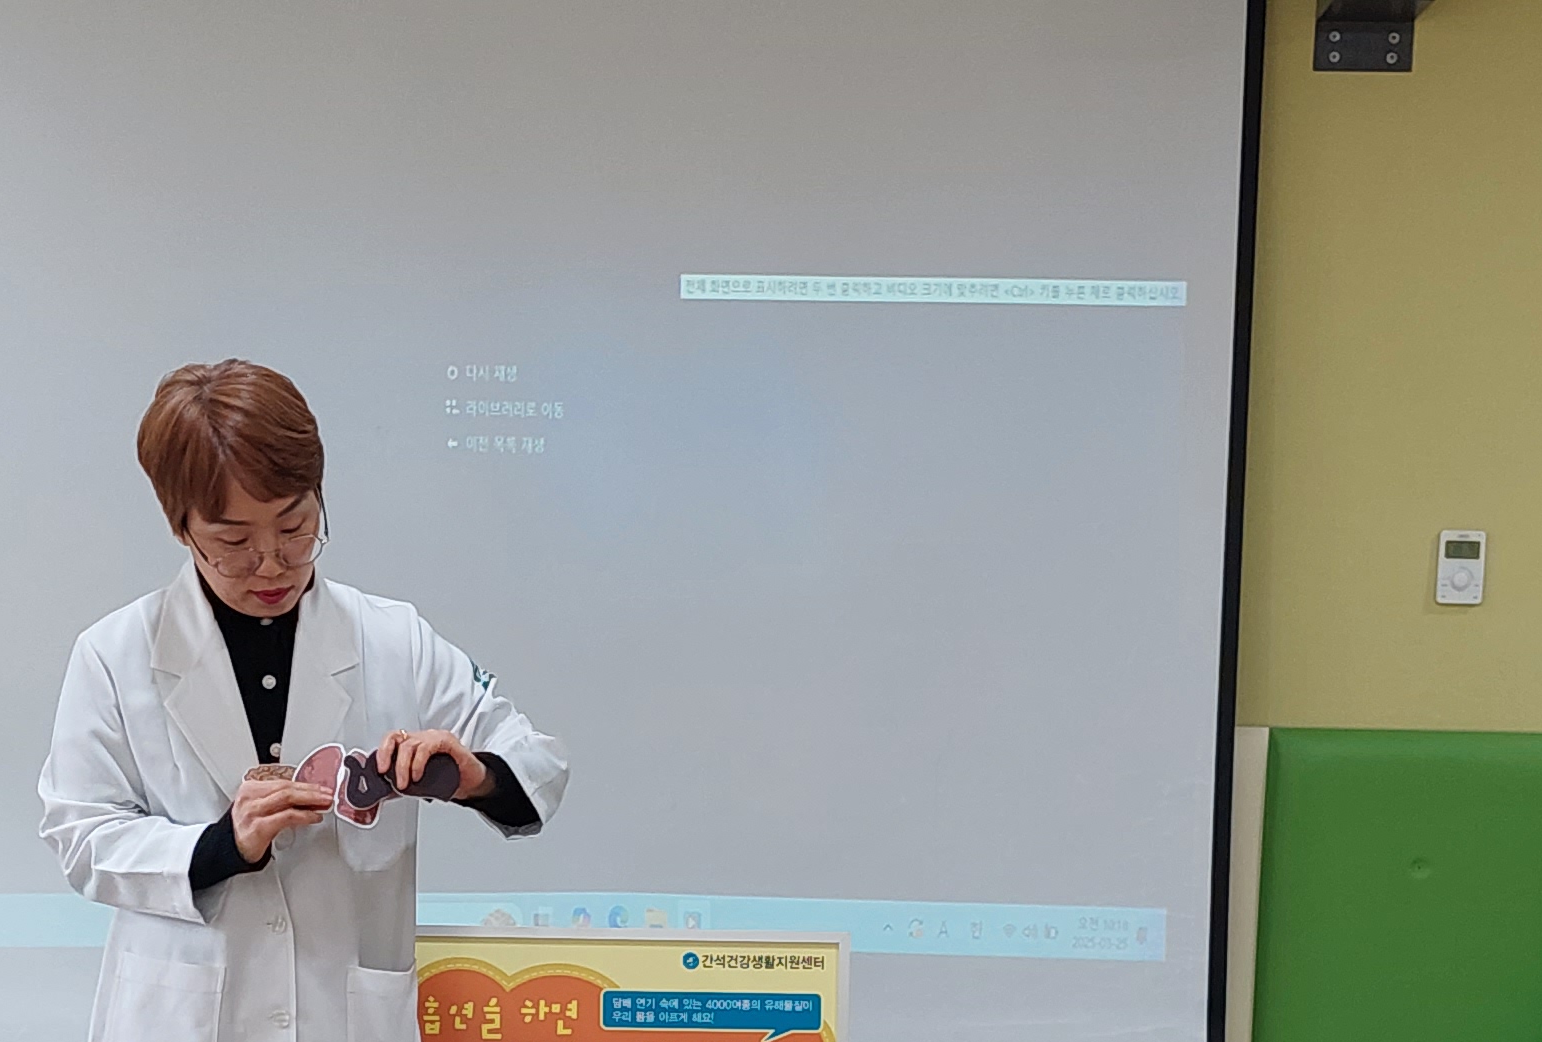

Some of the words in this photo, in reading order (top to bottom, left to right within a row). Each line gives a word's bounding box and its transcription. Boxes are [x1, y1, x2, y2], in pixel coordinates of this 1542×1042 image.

[465, 364, 490, 382] 다시
[493, 364, 518, 382] 재생
[465, 400, 538, 418] 라이브러리로
[541, 401, 565, 419] 이동
[700, 953, 827, 972] 간석건강생활지원센터
[612, 996, 633, 1011] 담배
[635, 997, 657, 1011] 연기
[682, 997, 703, 1012] 있는
[421, 994, 504, 1041] 흡연을
[519, 997, 580, 1037] 하면
[611, 1010, 633, 1024] 우리
[659, 1011, 690, 1025] 아프게
